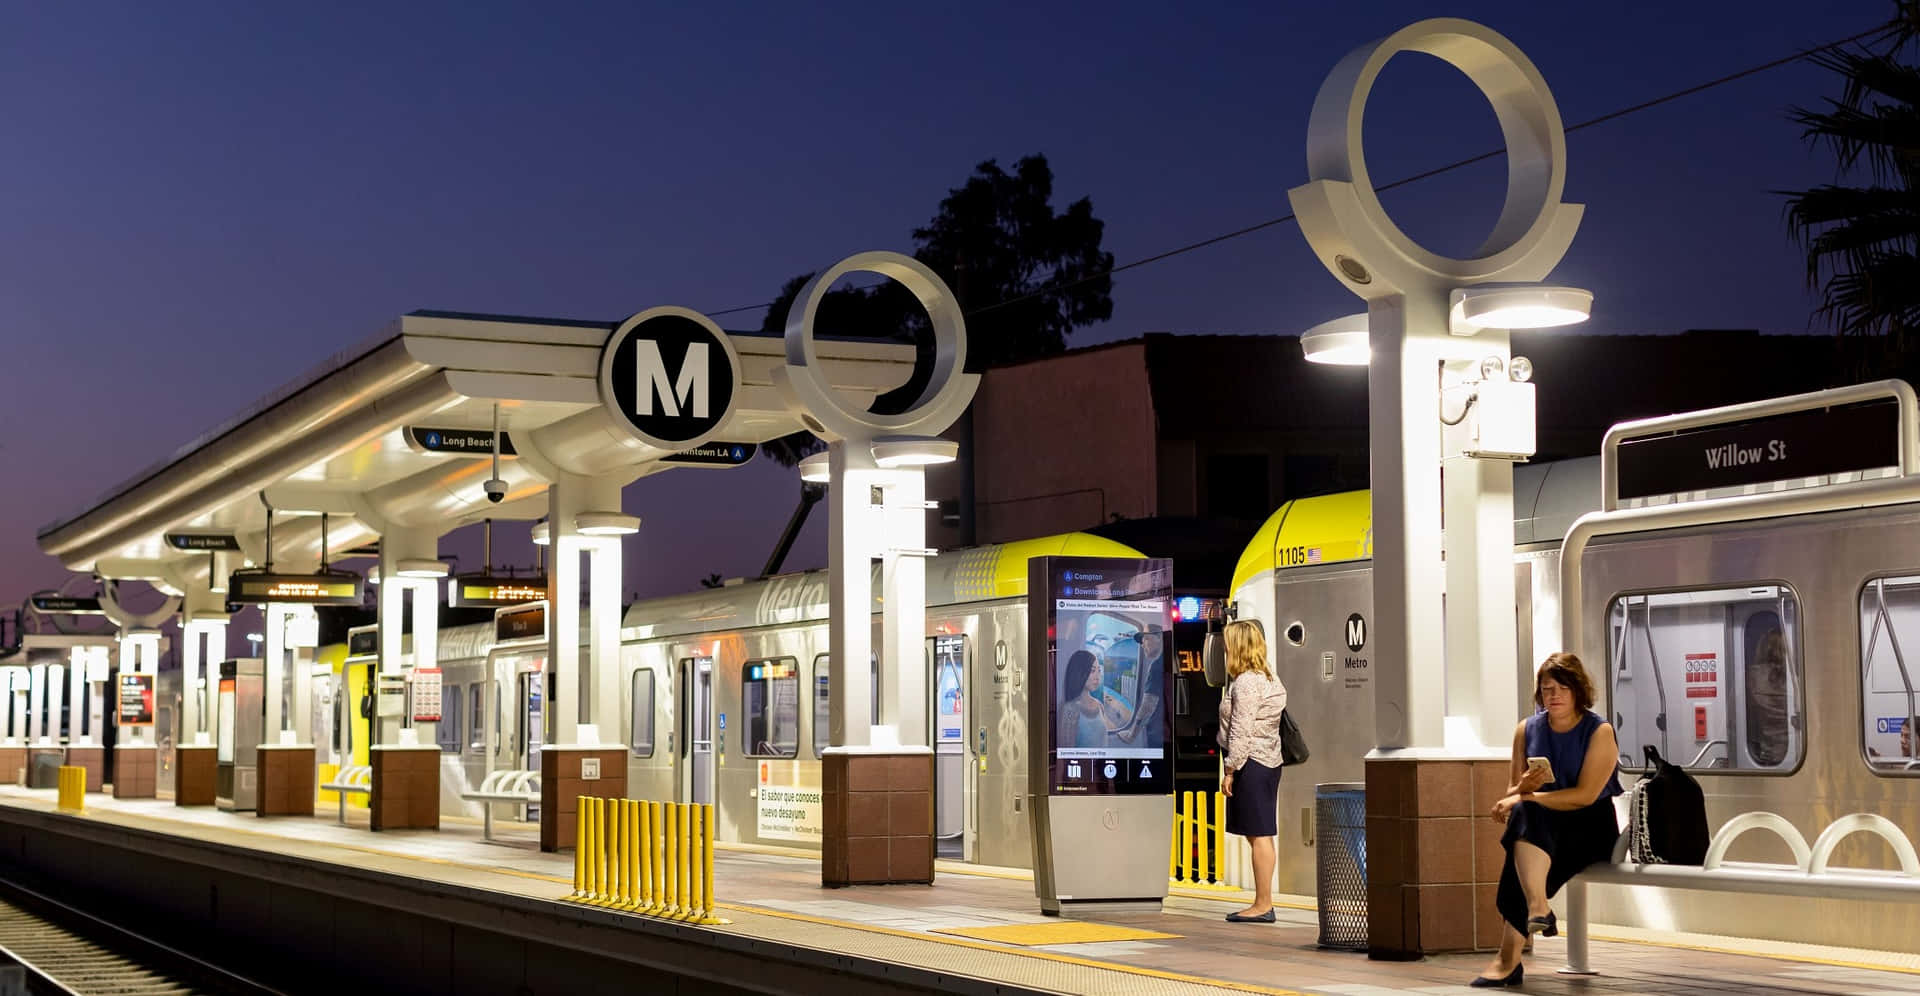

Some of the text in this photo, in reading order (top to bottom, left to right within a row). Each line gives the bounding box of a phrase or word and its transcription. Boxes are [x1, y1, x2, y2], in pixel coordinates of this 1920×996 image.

[636, 339, 709, 418] M
[442, 435, 465, 447] Long
[467, 437, 495, 447] Beach
[680, 447, 715, 456] wntown
[717, 448, 729, 456] LA
[1705, 440, 1786, 469] Willow St
[1279, 546, 1305, 566] 1105
[1074, 573, 1103, 582] Compton
[755, 575, 824, 625] Metro
[1348, 620, 1364, 646] M
[1345, 656, 1368, 669] Metro
[761, 789, 820, 806] El sabor que conoces
[761, 806, 806, 822] nuevo desayuno
